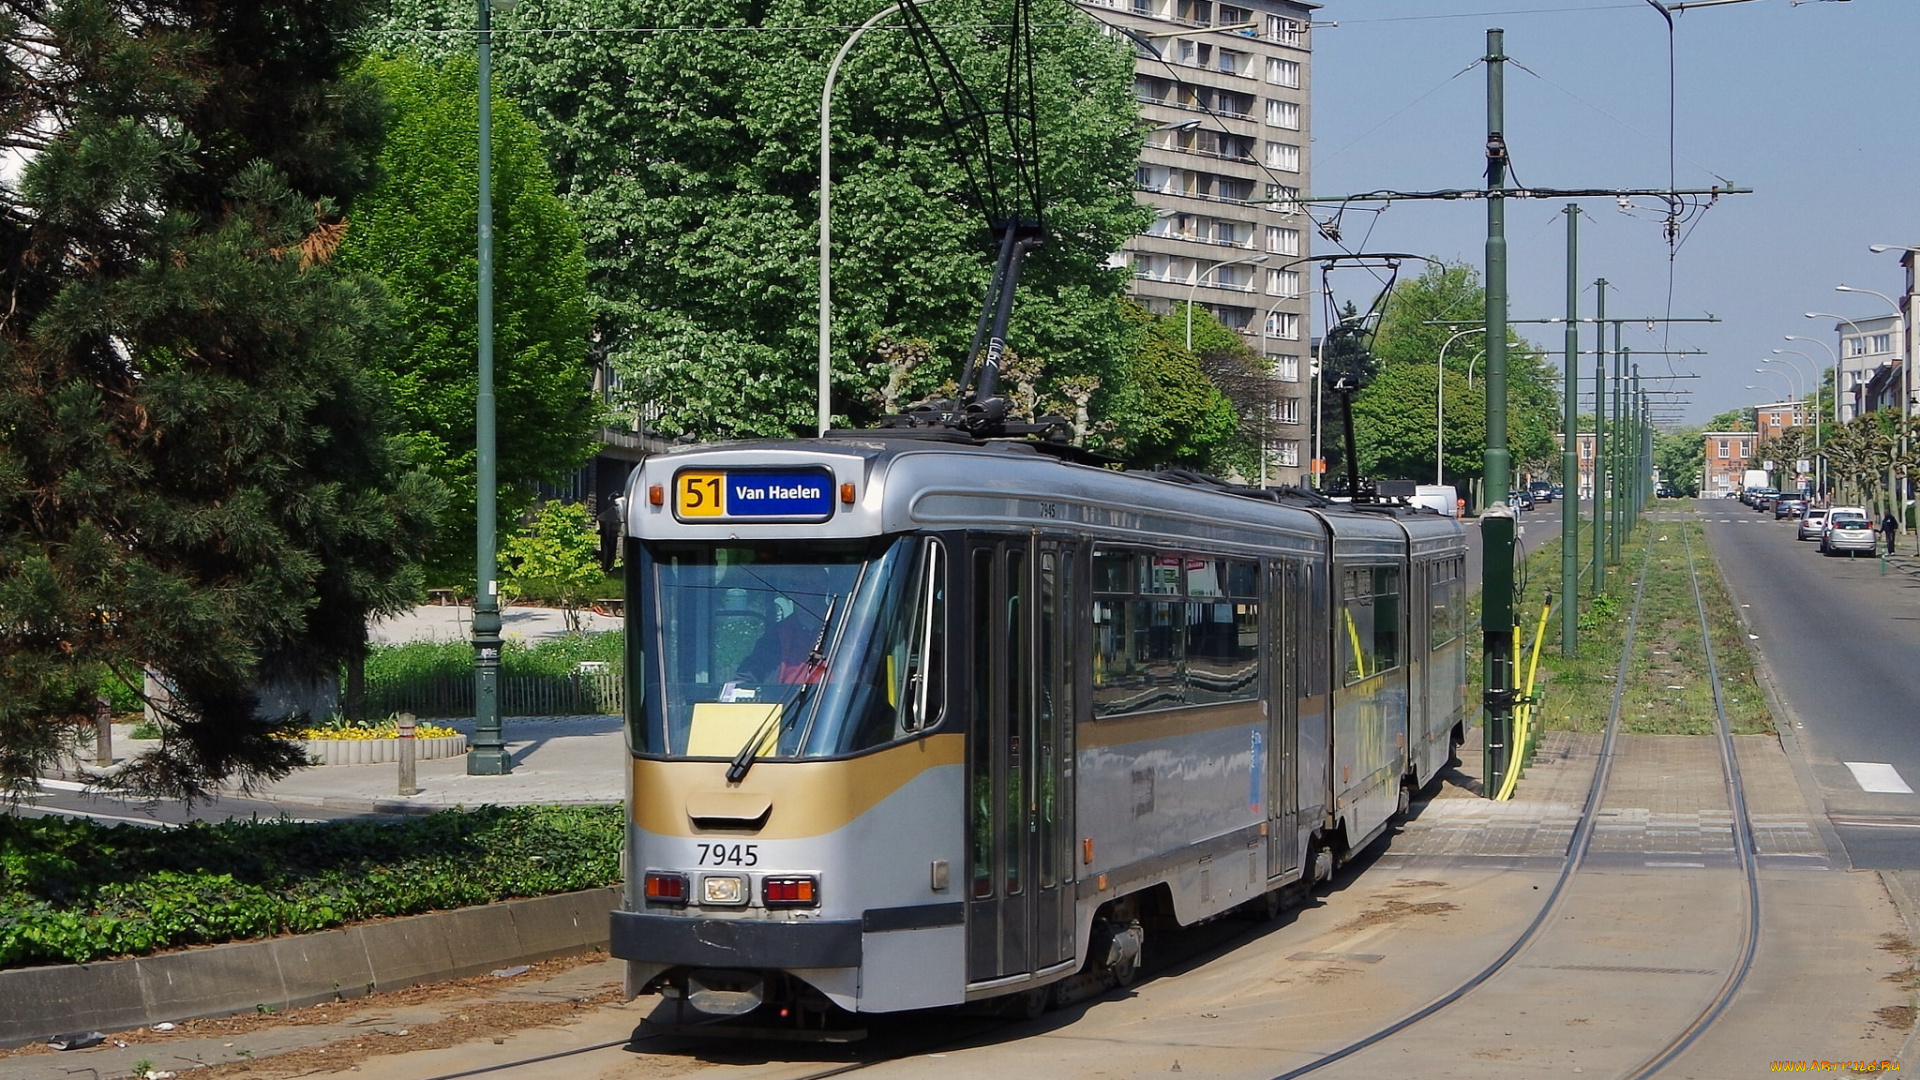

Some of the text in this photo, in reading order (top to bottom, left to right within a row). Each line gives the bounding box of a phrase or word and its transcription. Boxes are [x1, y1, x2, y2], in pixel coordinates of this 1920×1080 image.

[686, 478, 721, 508] 51
[735, 484, 820, 500] Van Haelen
[1040, 502, 1056, 518] 7945
[696, 843, 759, 866] 7945
